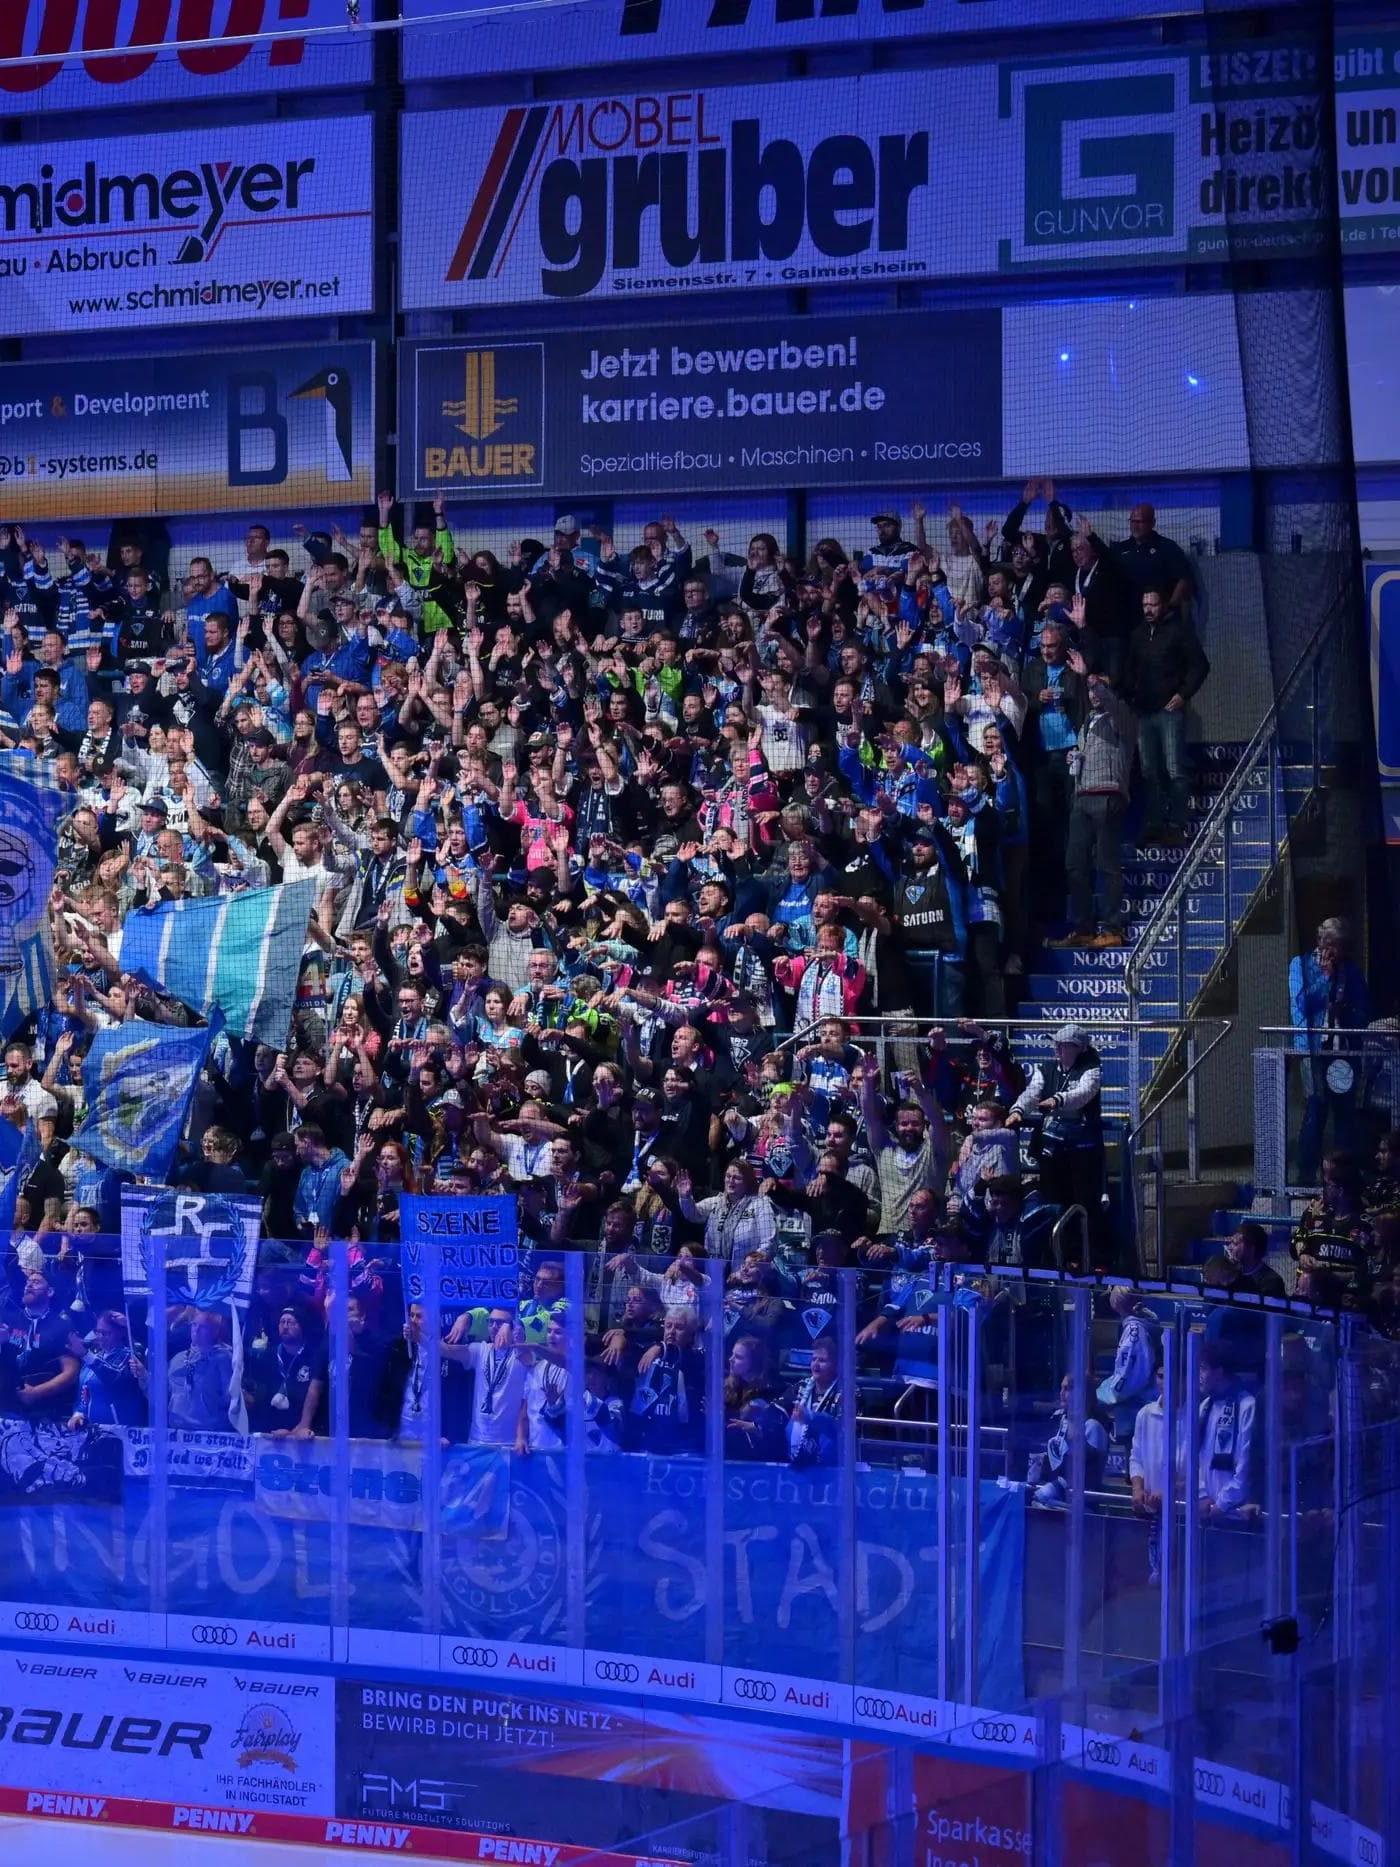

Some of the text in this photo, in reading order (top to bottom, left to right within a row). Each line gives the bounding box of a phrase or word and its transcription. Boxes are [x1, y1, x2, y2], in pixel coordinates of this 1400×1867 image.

[545, 93, 720, 155] MÖBEL
[1201, 105, 1319, 157] Heizö
[539, 118, 929, 298] gruber
[1034, 203, 1164, 236] GUNVOR
[46, 242, 157, 273] Abbruch
[613, 260, 927, 291] Siemensstr. 7 Gaimersheim
[69, 276, 340, 314] www.schmidmeyer.net
[580, 337, 857, 380] Jetzt bewerben!
[74, 389, 209, 417] Development
[582, 382, 886, 423] karriere.bauer.de
[425, 444, 535, 479] BAUER
[580, 441, 982, 477] Spezialtiefbau Maschinen Resources
[903, 909, 944, 928] SATURN
[1057, 980, 1152, 997] NORDBRU
[417, 1208, 500, 1235] SZENE
[407, 1243, 518, 1268] VRUND
[408, 1275, 519, 1300] SCHZIG
[67, 1616, 116, 1636] Audi
[246, 1630, 297, 1649] Audi
[506, 1652, 557, 1673] Audi
[647, 1668, 696, 1689] Audi
[362, 1688, 611, 1731] BRING DEN PUCK INS NETZ
[784, 1686, 831, 1709] Audi
[895, 1706, 937, 1727] Audi
[230, 1727, 302, 1752] Fairplay
[362, 1713, 556, 1749] BEWIRB DICH JETZT!
[1128, 1754, 1159, 1776] Audi
[216, 1774, 316, 1793] IHR FACHHÄNDLER
[1231, 1782, 1266, 1809] Audi
[26, 1792, 106, 1818] PENNY
[225, 1790, 307, 1807] IN INGOLSTADT
[173, 1807, 255, 1832] PENNY
[362, 1808, 511, 1832] FUTURE MOBILITY SOLUTIONS
[927, 1810, 1033, 1855] Sparkasse
[325, 1822, 411, 1848] PENNY
[479, 1837, 560, 1866] PENNY
